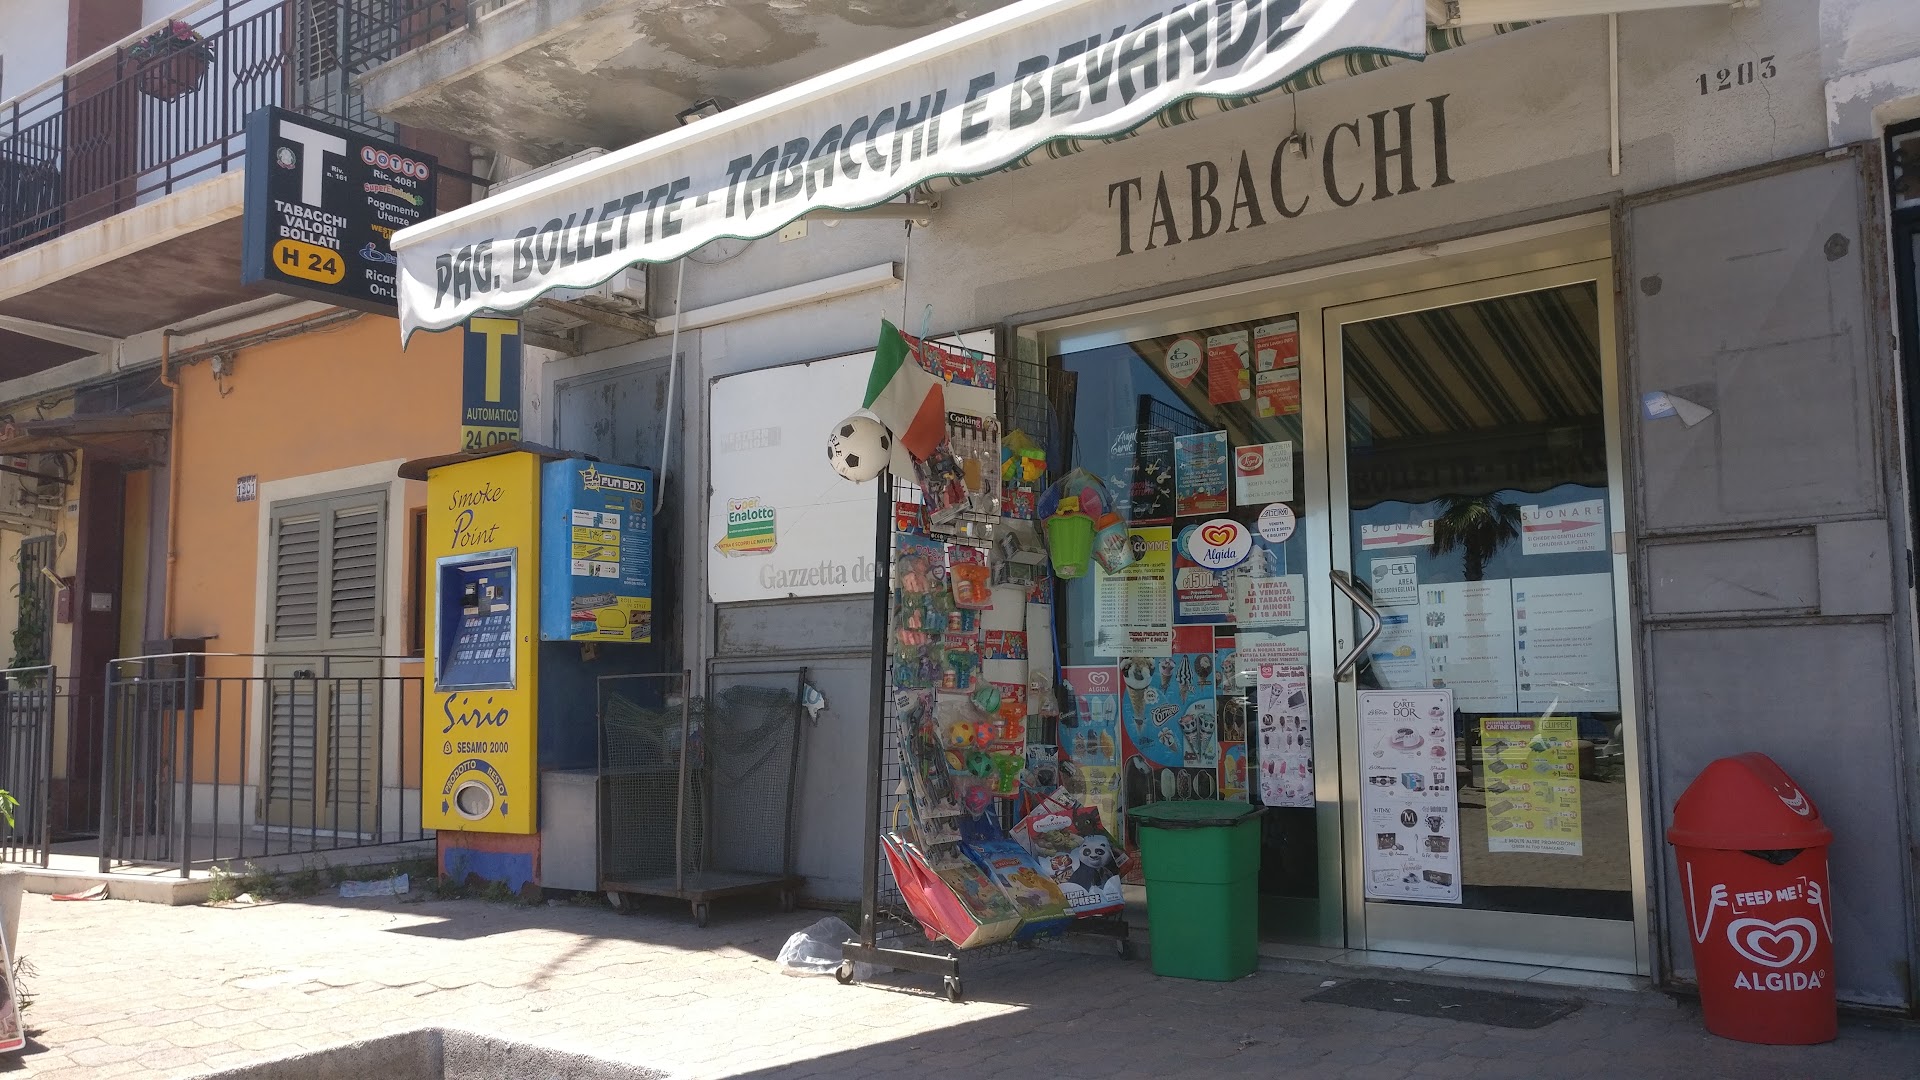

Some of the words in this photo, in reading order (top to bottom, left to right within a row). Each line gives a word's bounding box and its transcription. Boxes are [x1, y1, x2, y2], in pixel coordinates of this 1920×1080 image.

[1695, 55, 1777, 96] 1203
[279, 119, 347, 208] T
[362, 147, 429, 180] LOTTO
[433, 238, 501, 310] PAG.
[512, 176, 691, 284] BOLLETTE
[725, 89, 949, 221] TABACCHI
[960, 71, 996, 146] E
[1008, 0, 1307, 130] BEVANDE
[331, 165, 344, 174] Riv.
[373, 169, 392, 183] Ric.
[394, 175, 417, 189] 4081
[1108, 93, 1456, 257] TABACCHI
[275, 200, 347, 229] TABACCHI
[367, 196, 420, 218] Pagamento
[377, 208, 410, 226] Utenze
[285, 214, 337, 238] VALORI
[371, 224, 396, 234] WEST
[280, 226, 340, 250] BOLLATI
[282, 246, 299, 267] H
[307, 253, 337, 276] 24
[365, 269, 396, 285] Ricar
[370, 284, 397, 298] On-L
[469, 317, 519, 403] T
[466, 407, 518, 423] AUTOMATICO
[949, 413, 981, 429] Cooking
[466, 430, 482, 450] 24
[584, 471, 600, 483] 24
[601, 477, 621, 488] FUN
[622, 480, 644, 492] BOX
[448, 481, 505, 512] Smoke
[729, 508, 774, 523] Enalotto
[1522, 506, 1604, 521] SUONARE
[451, 508, 500, 549] Point
[1134, 541, 1169, 552] GOMME
[1203, 548, 1237, 565] Algida
[759, 559, 848, 591] Gazzetta
[852, 556, 876, 583] de
[1259, 588, 1292, 596] VENDITA
[442, 692, 509, 734] Sirio
[1393, 707, 1422, 719] D'OR
[1543, 721, 1570, 729] CLIPPER
[457, 741, 488, 754] SESAMO
[489, 741, 509, 754] 2000
[444, 760, 477, 794] PRODOTTO
[486, 766, 505, 795] RESTO
[1735, 890, 1772, 907] FEED
[1734, 970, 1822, 992] ALGIDA
